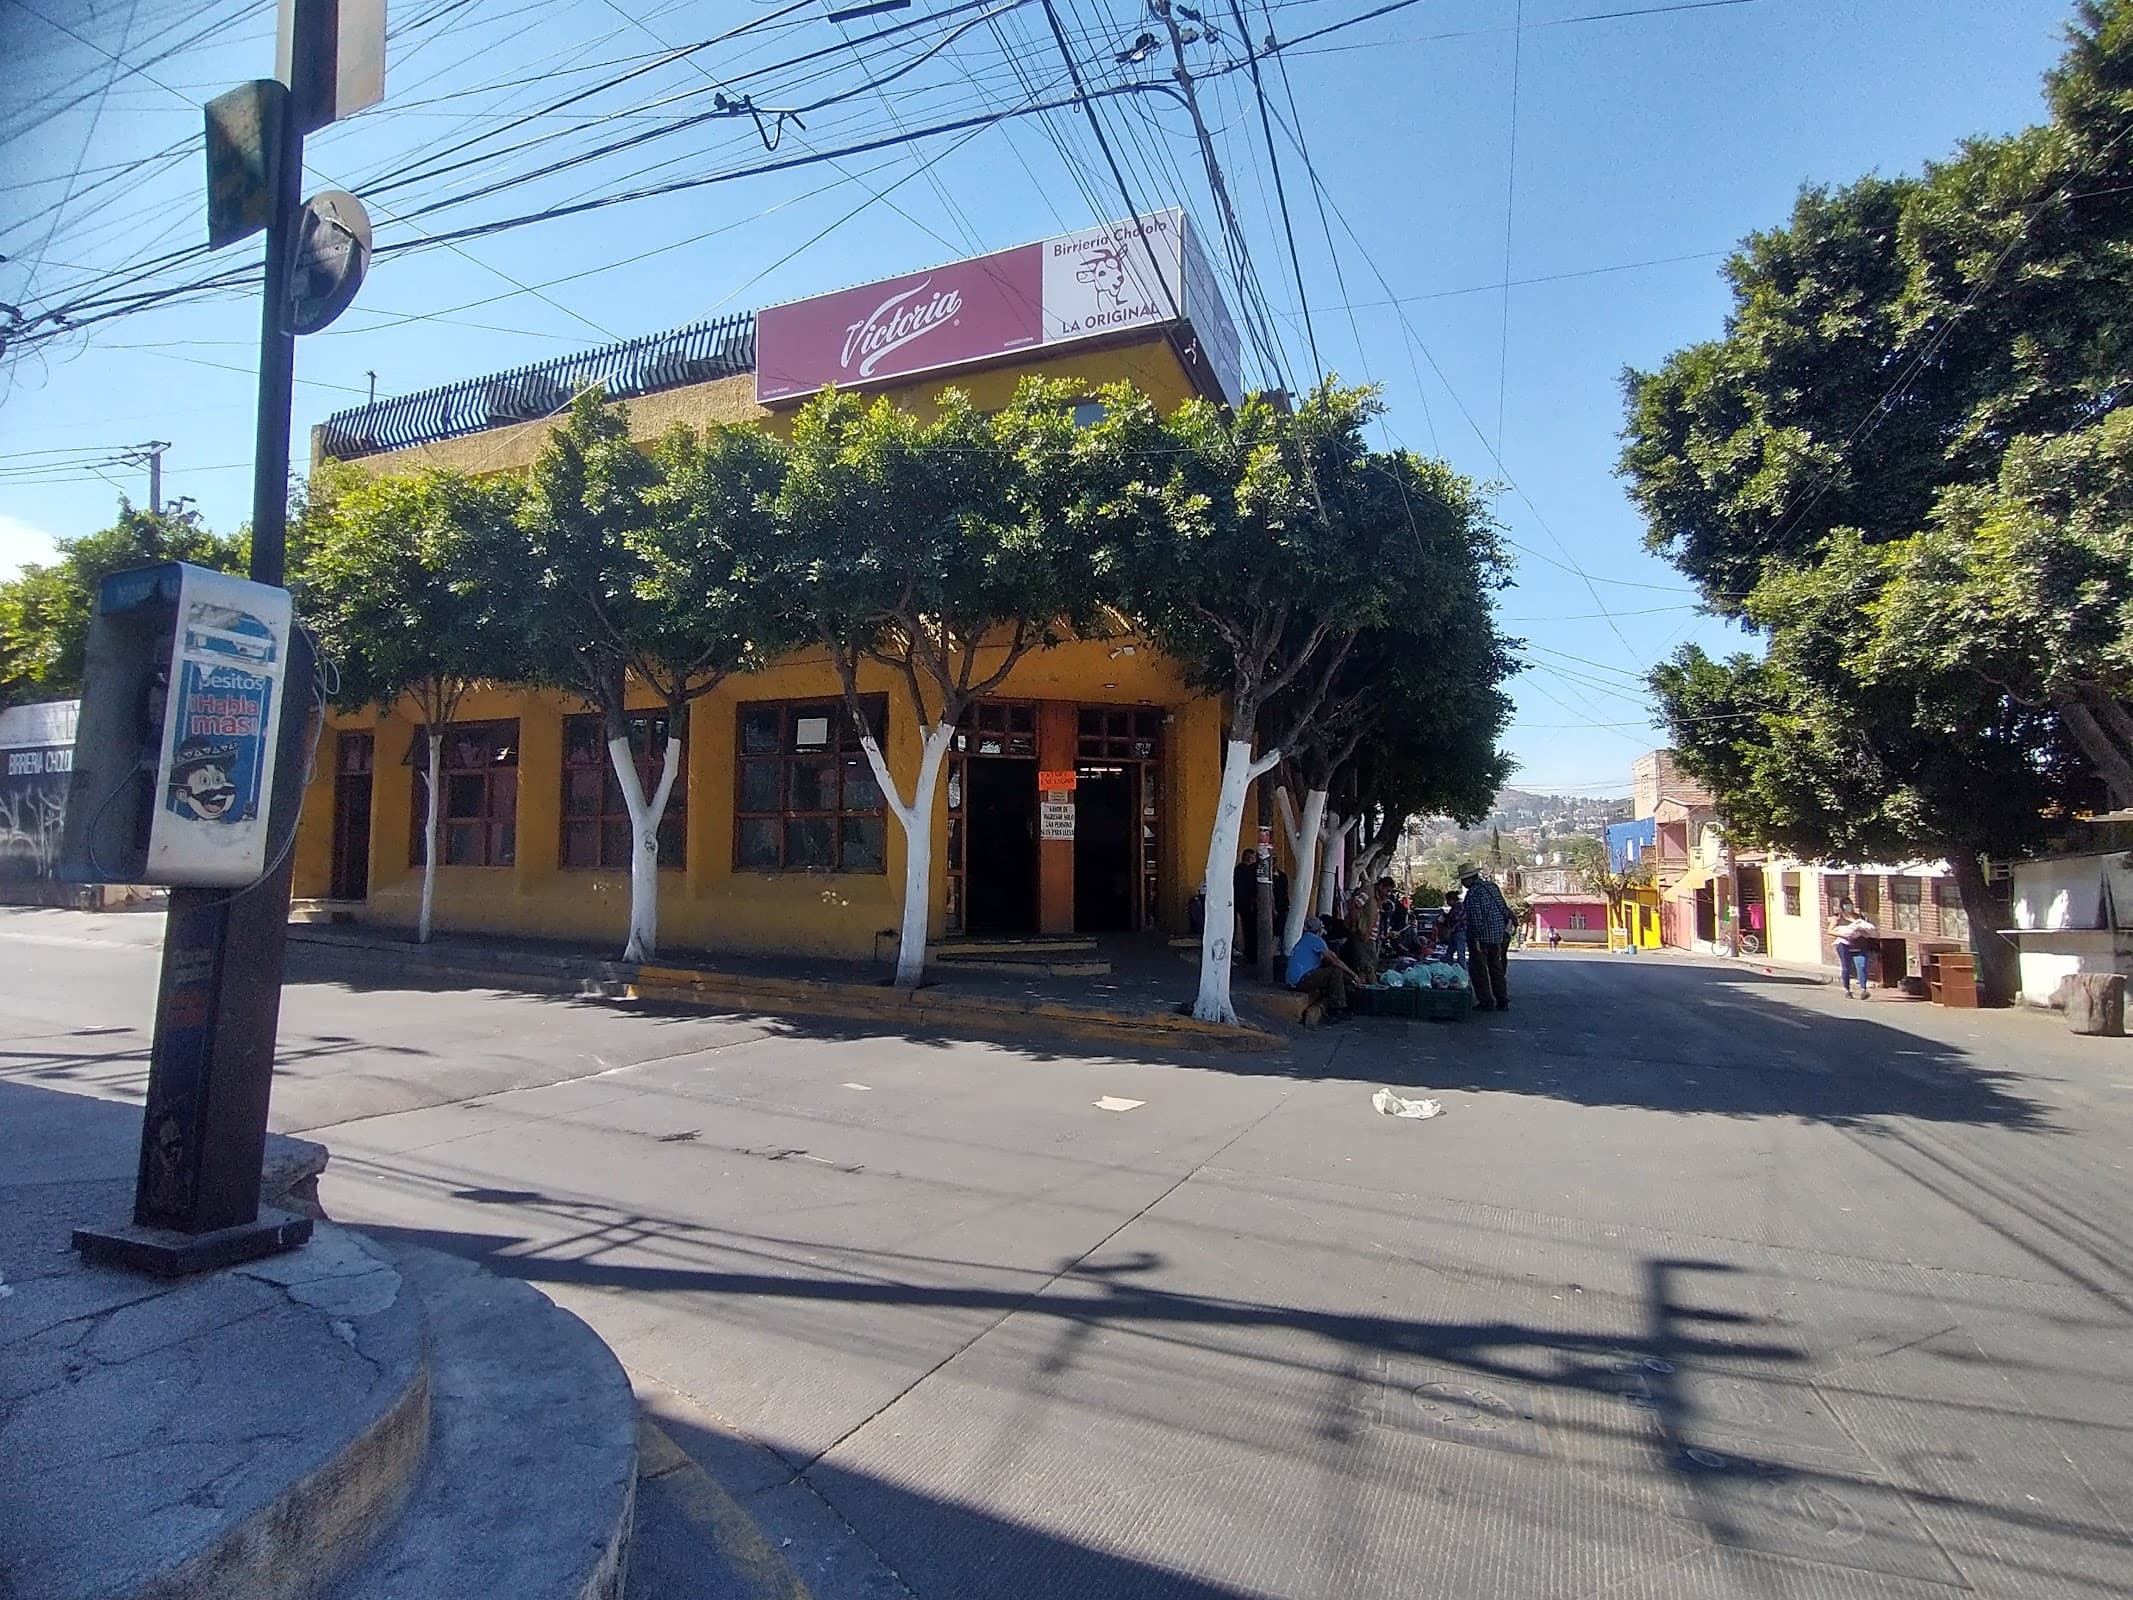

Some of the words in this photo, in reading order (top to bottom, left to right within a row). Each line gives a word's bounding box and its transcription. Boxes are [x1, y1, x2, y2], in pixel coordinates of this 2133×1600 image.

[1113, 221, 1167, 241] Chololo
[840, 275, 963, 377] Victoria
[1062, 320, 1081, 334] LA
[1085, 304, 1159, 329] ORIGINAL
